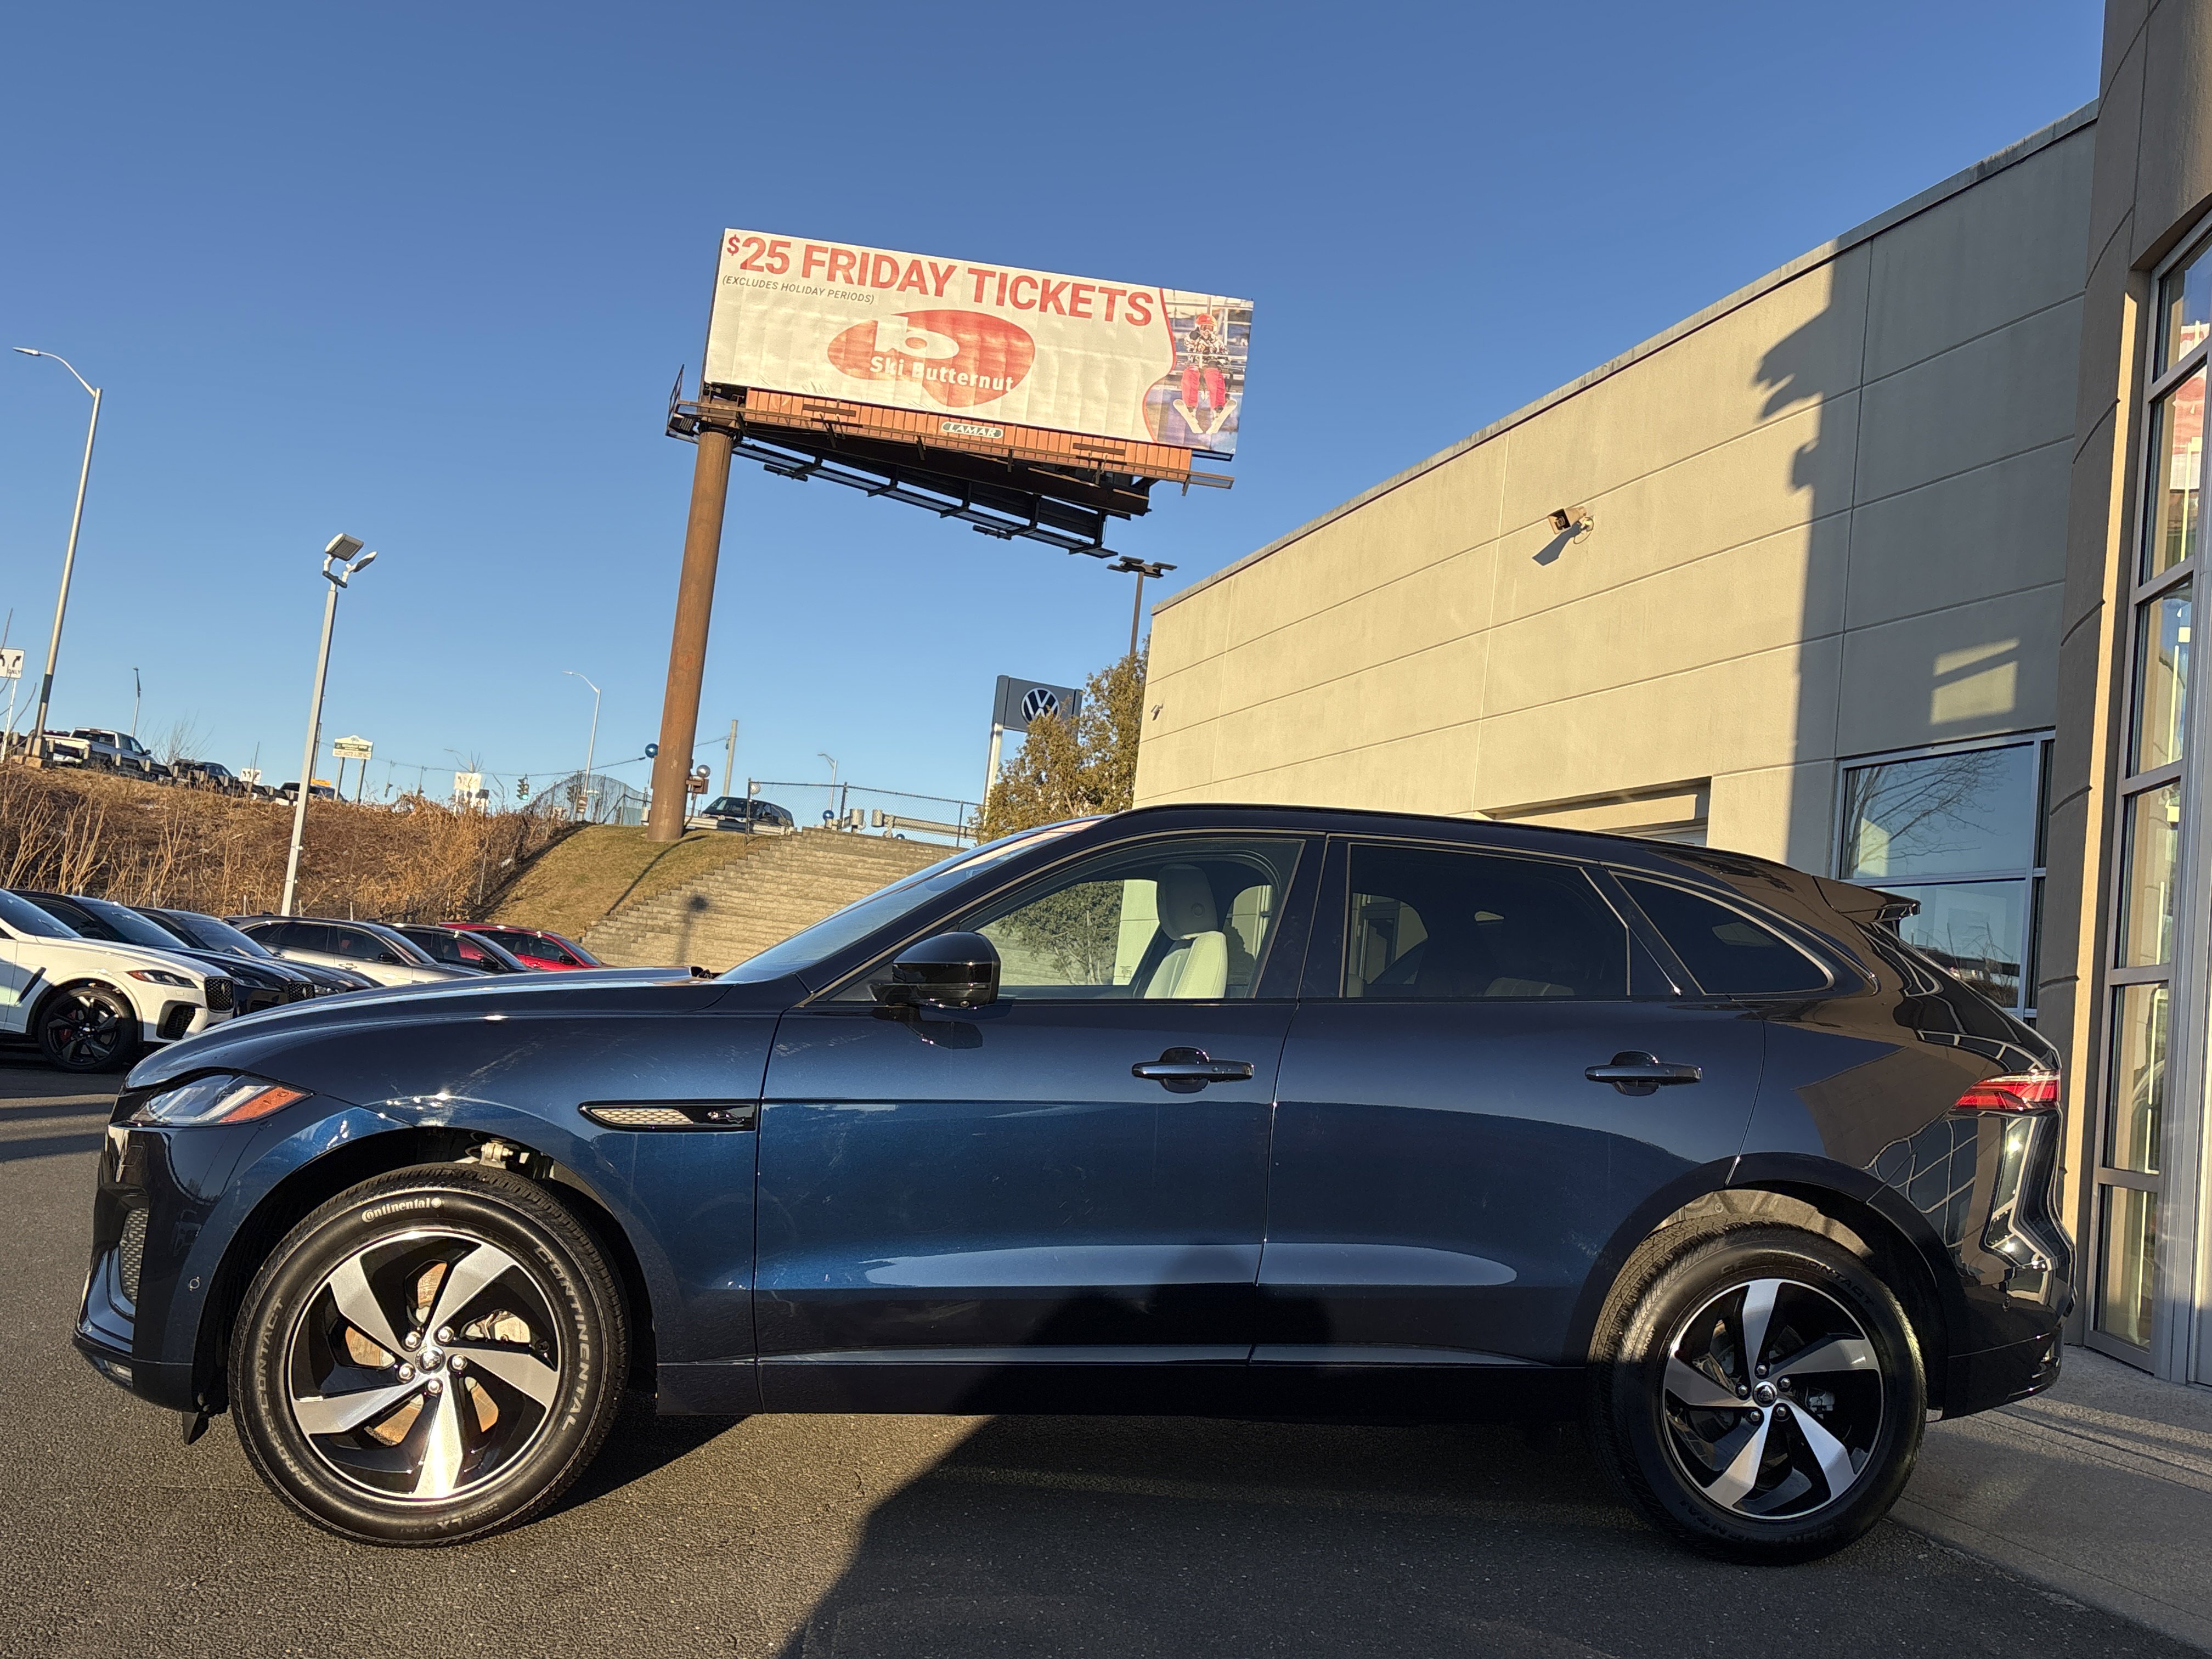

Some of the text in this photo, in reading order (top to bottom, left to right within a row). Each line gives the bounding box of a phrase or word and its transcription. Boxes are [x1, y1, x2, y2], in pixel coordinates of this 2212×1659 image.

[722, 274, 874, 305] (EXCLUDES HOLIDAY PERIODS)
[727, 234, 1154, 326] $25 FRIDAY TICKETS
[870, 356, 1013, 392] Ski Butternut
[949, 423, 998, 438] LAMAR
[361, 1198, 430, 1223] Continental
[533, 1246, 590, 1431] CONTINENTAL
